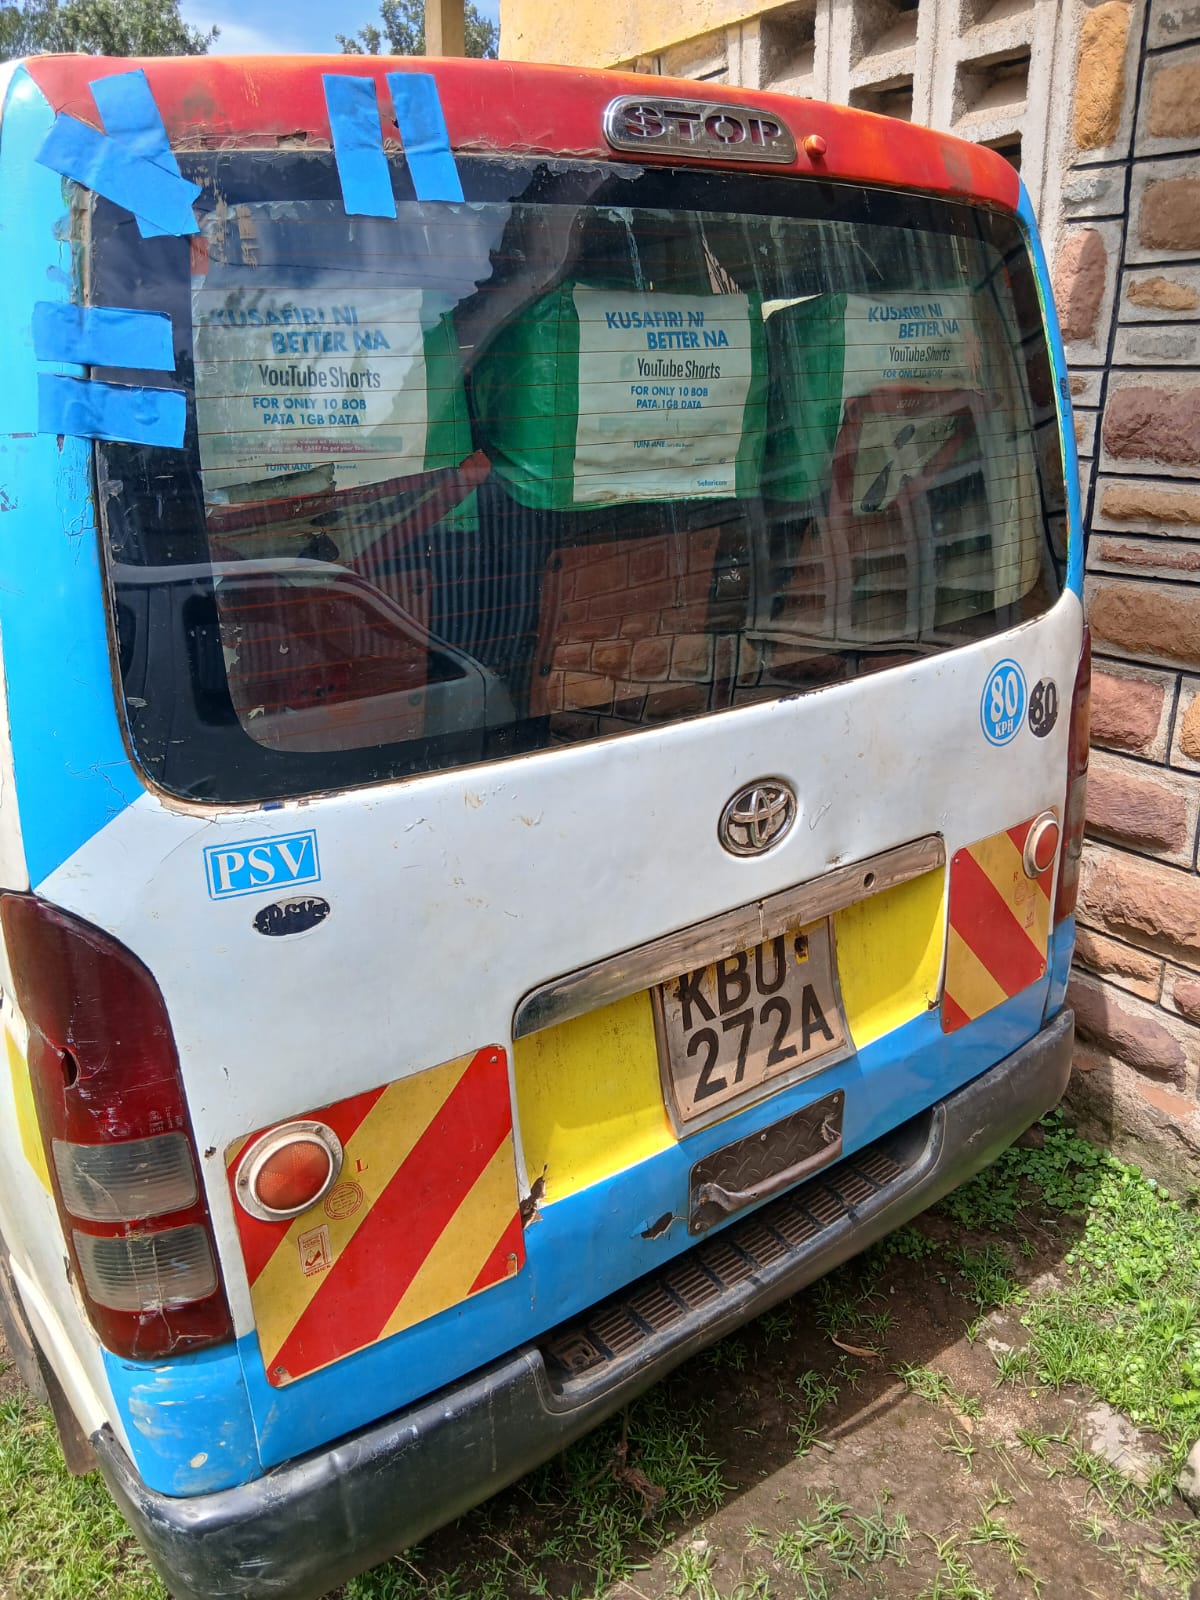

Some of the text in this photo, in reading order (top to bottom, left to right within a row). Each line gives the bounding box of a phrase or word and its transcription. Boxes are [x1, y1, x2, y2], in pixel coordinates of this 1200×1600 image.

[624, 106, 782, 147] STOP
[209, 305, 359, 329] KUSAFIRI NI
[605, 311, 704, 329] KUSAFIRI NI
[868, 303, 943, 322] KUSAFIRI NI
[898, 319, 960, 339] BETTER NA
[271, 329, 391, 354] BETTER NA
[647, 330, 729, 350] BETTER NA
[889, 346, 951, 362] YouTube Shorts
[258, 364, 381, 389] YouTube Shorts
[637, 357, 721, 379] YouTube Shorts
[882, 370, 897, 378] FOR
[630, 385, 708, 397] FOR ONLY 10 BOB
[252, 397, 367, 410] FOR ONLY 10 BOB
[636, 399, 702, 410] PATA 1GB DATA
[263, 413, 360, 425] PATA 1GB DATA
[990, 670, 1019, 723] 80
[1029, 680, 1057, 726] 80
[995, 718, 1014, 737] KPH
[213, 839, 310, 891] PSV
[678, 935, 787, 1032] KBU
[686, 983, 835, 1103] 272A
